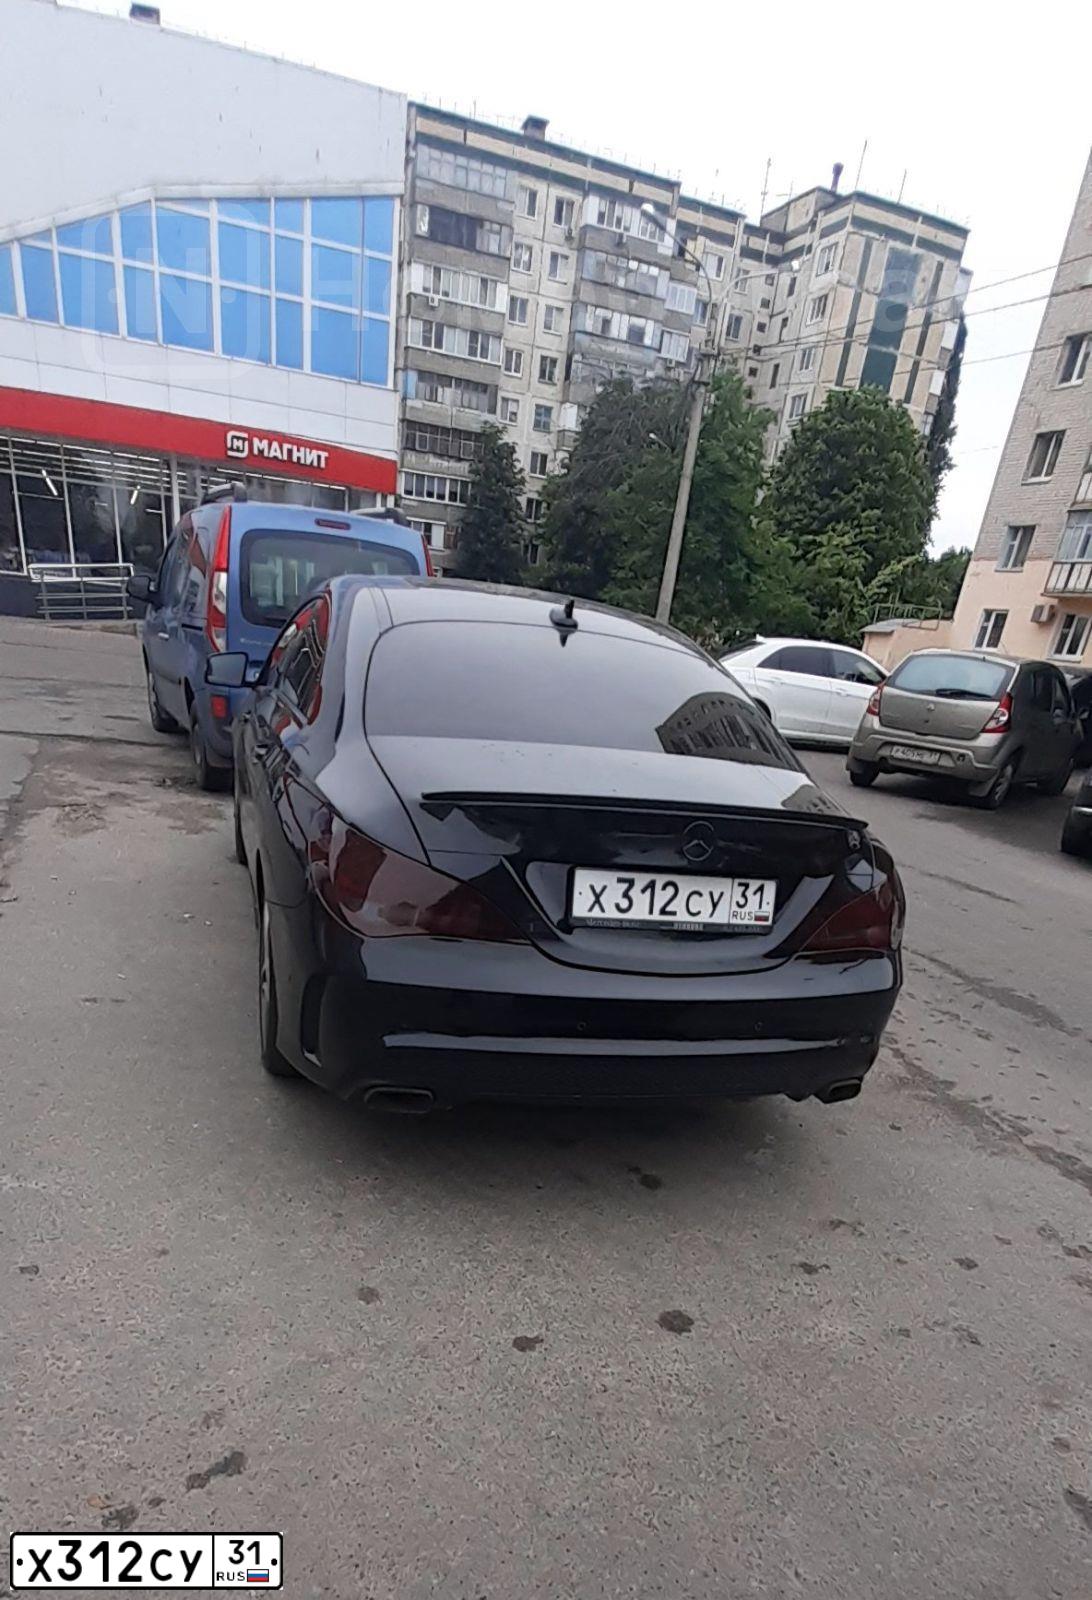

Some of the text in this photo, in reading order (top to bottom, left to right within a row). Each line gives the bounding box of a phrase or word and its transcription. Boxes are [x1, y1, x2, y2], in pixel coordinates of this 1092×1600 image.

[252, 437, 329, 468] МАГНИТ
[587, 876, 724, 918] Х312СУ
[735, 882, 765, 910] 31
[732, 910, 754, 921] RUS
